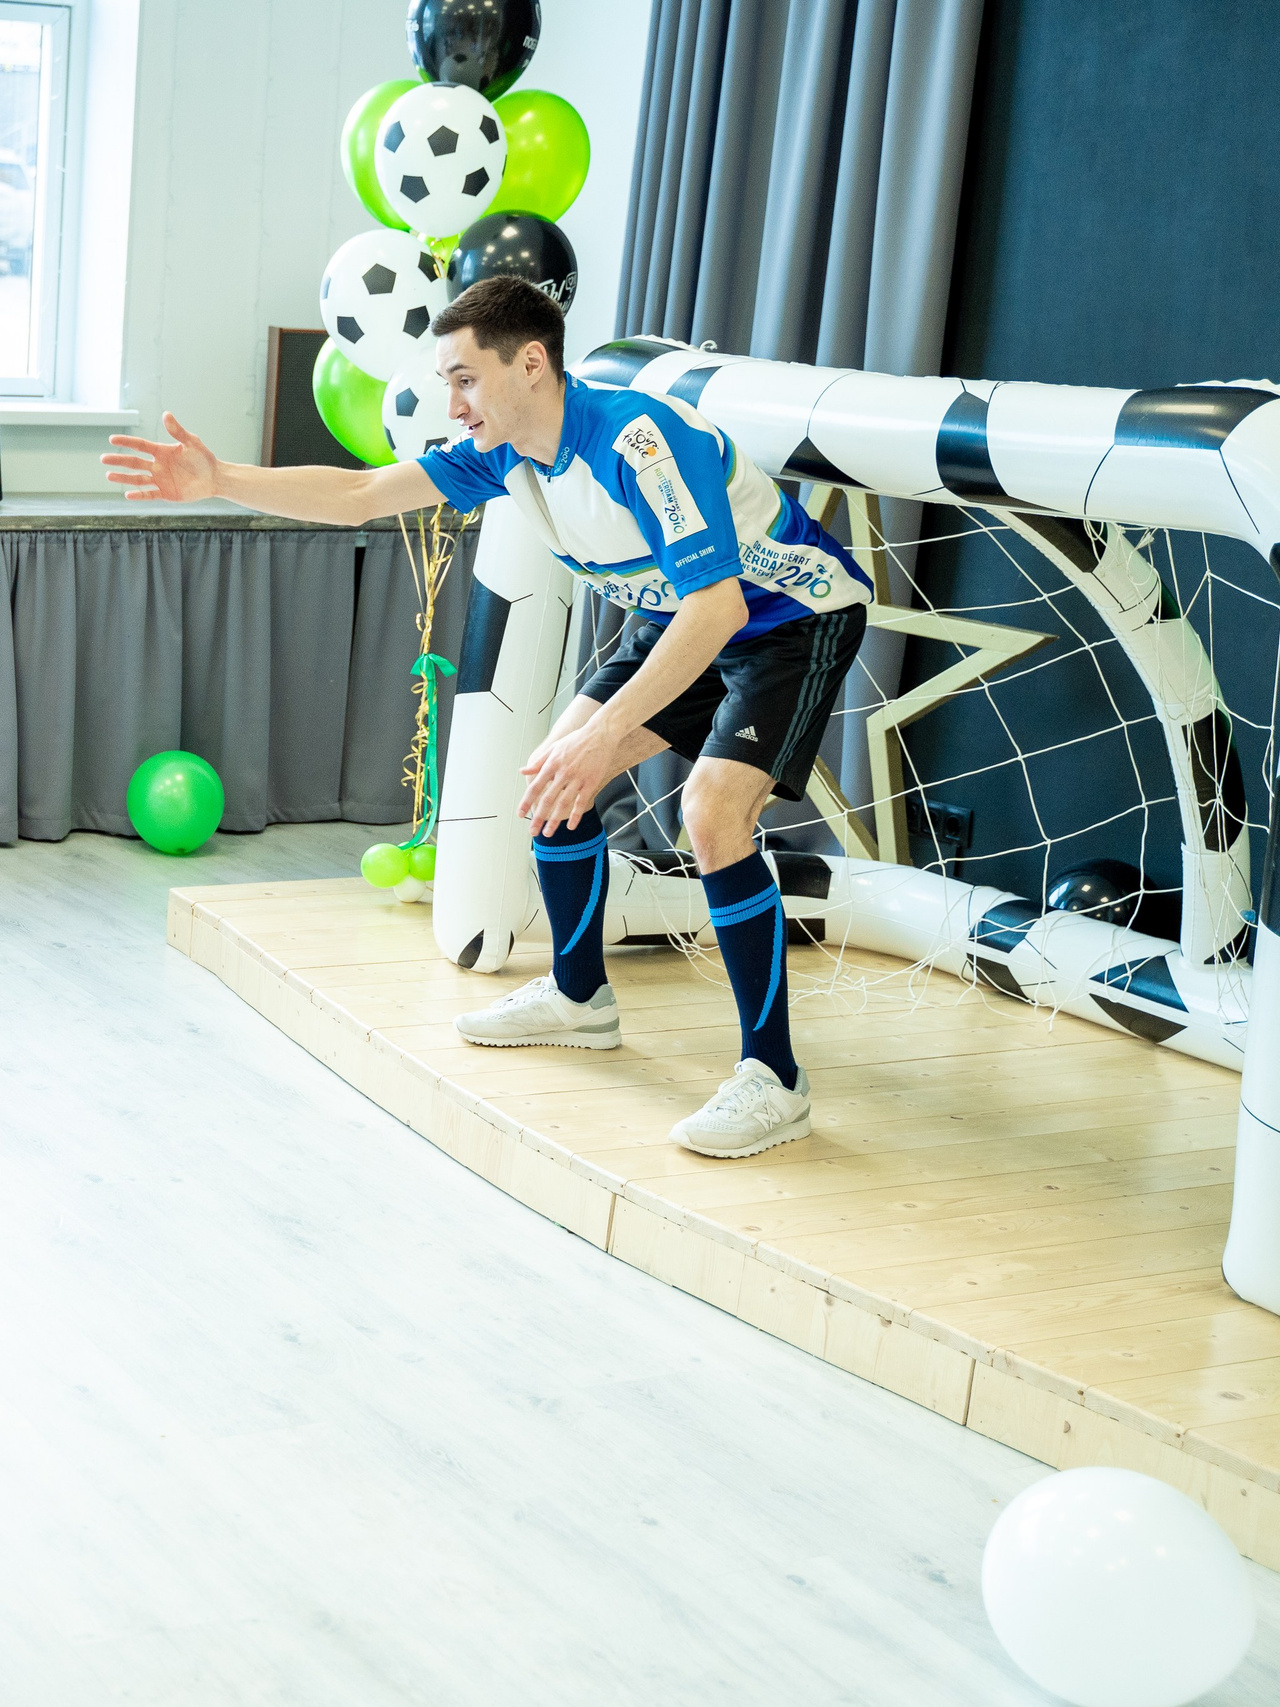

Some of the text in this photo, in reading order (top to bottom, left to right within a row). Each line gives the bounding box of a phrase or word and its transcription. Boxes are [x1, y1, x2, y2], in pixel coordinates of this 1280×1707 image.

[654, 467, 685, 534] ROTTERDAM 2010
[674, 545, 716, 568] OFFICIAL SHIRT
[753, 540, 780, 560] GRAND
[774, 565, 832, 599] 2010
[734, 731, 758, 742] adidas
